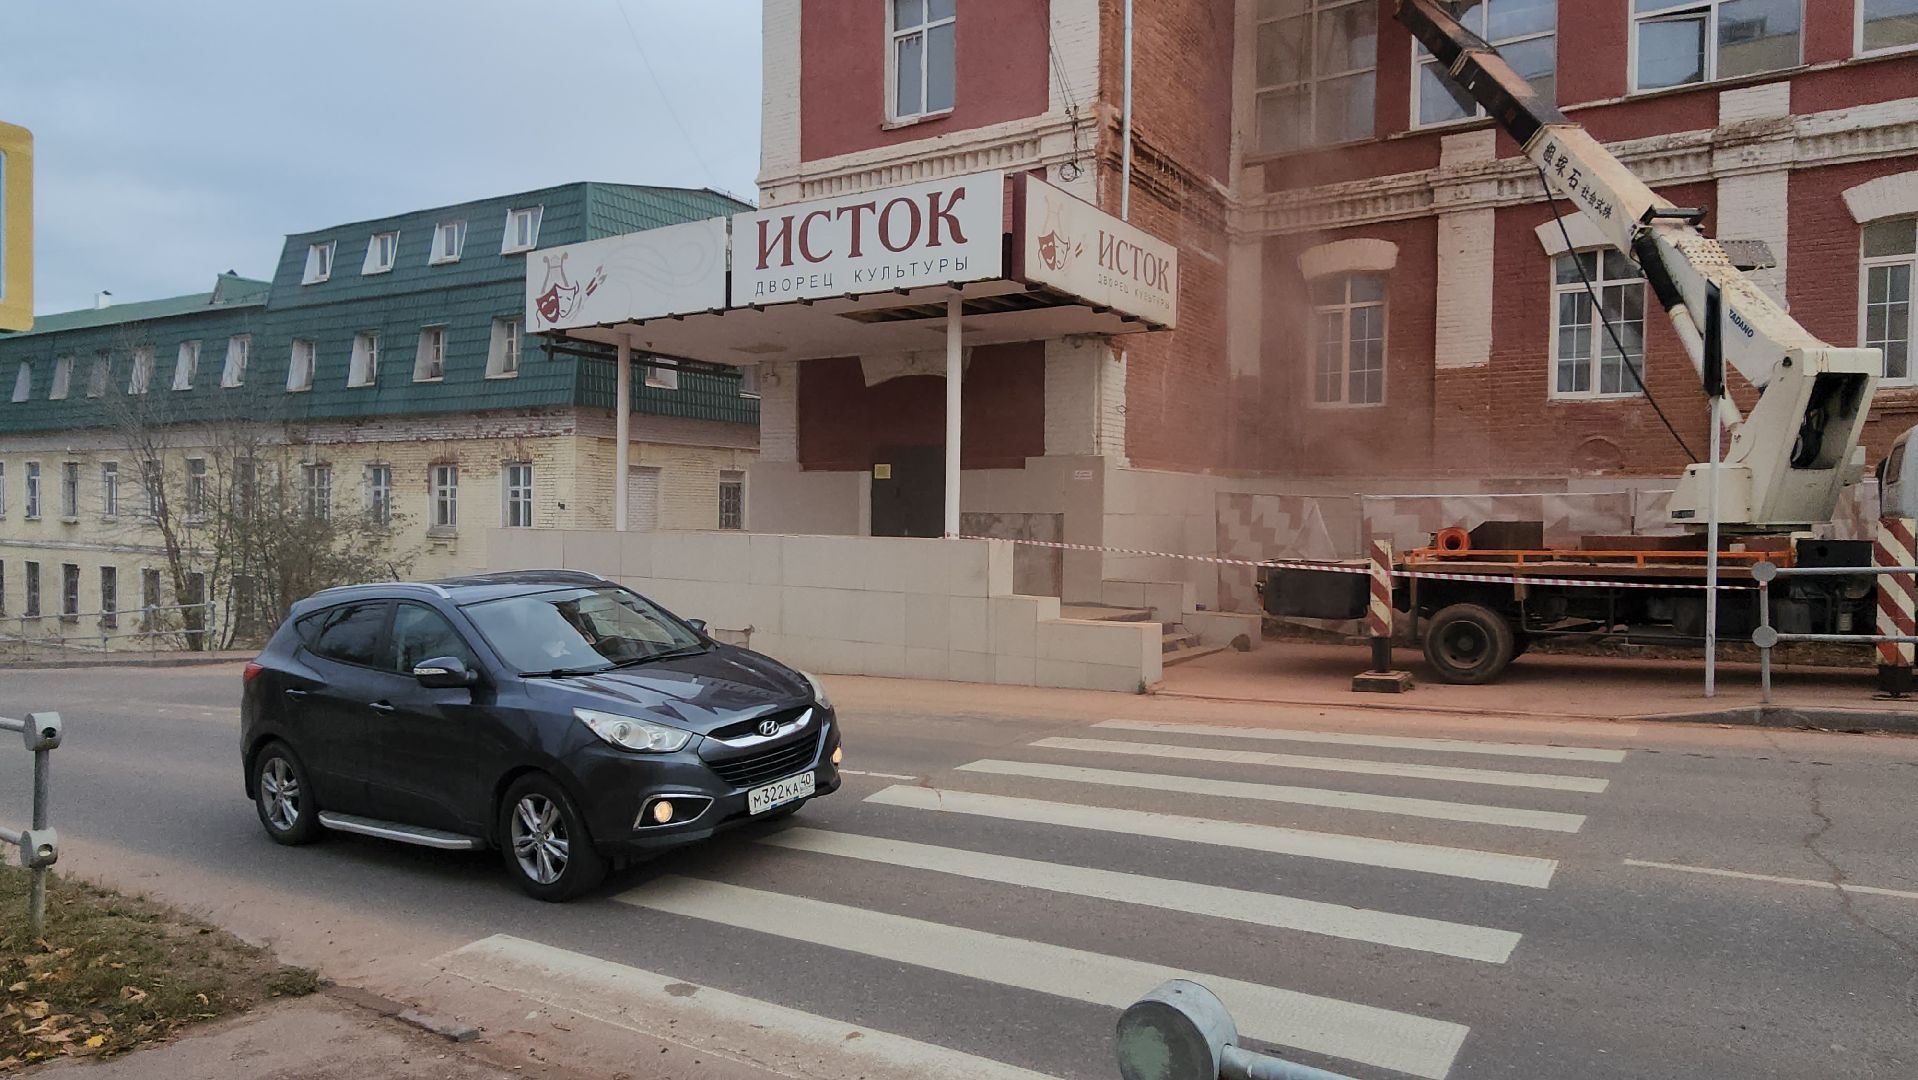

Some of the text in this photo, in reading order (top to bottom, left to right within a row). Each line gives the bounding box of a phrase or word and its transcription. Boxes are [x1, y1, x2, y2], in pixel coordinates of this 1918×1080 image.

[755, 186, 969, 271] ИСТОК
[755, 255, 969, 297] ДВОРЕЦ КУЛЬТУРЫ
[1098, 229, 1170, 295] ИСТОК
[1728, 308, 1754, 338] TADANO
[800, 773, 811, 786] 40
